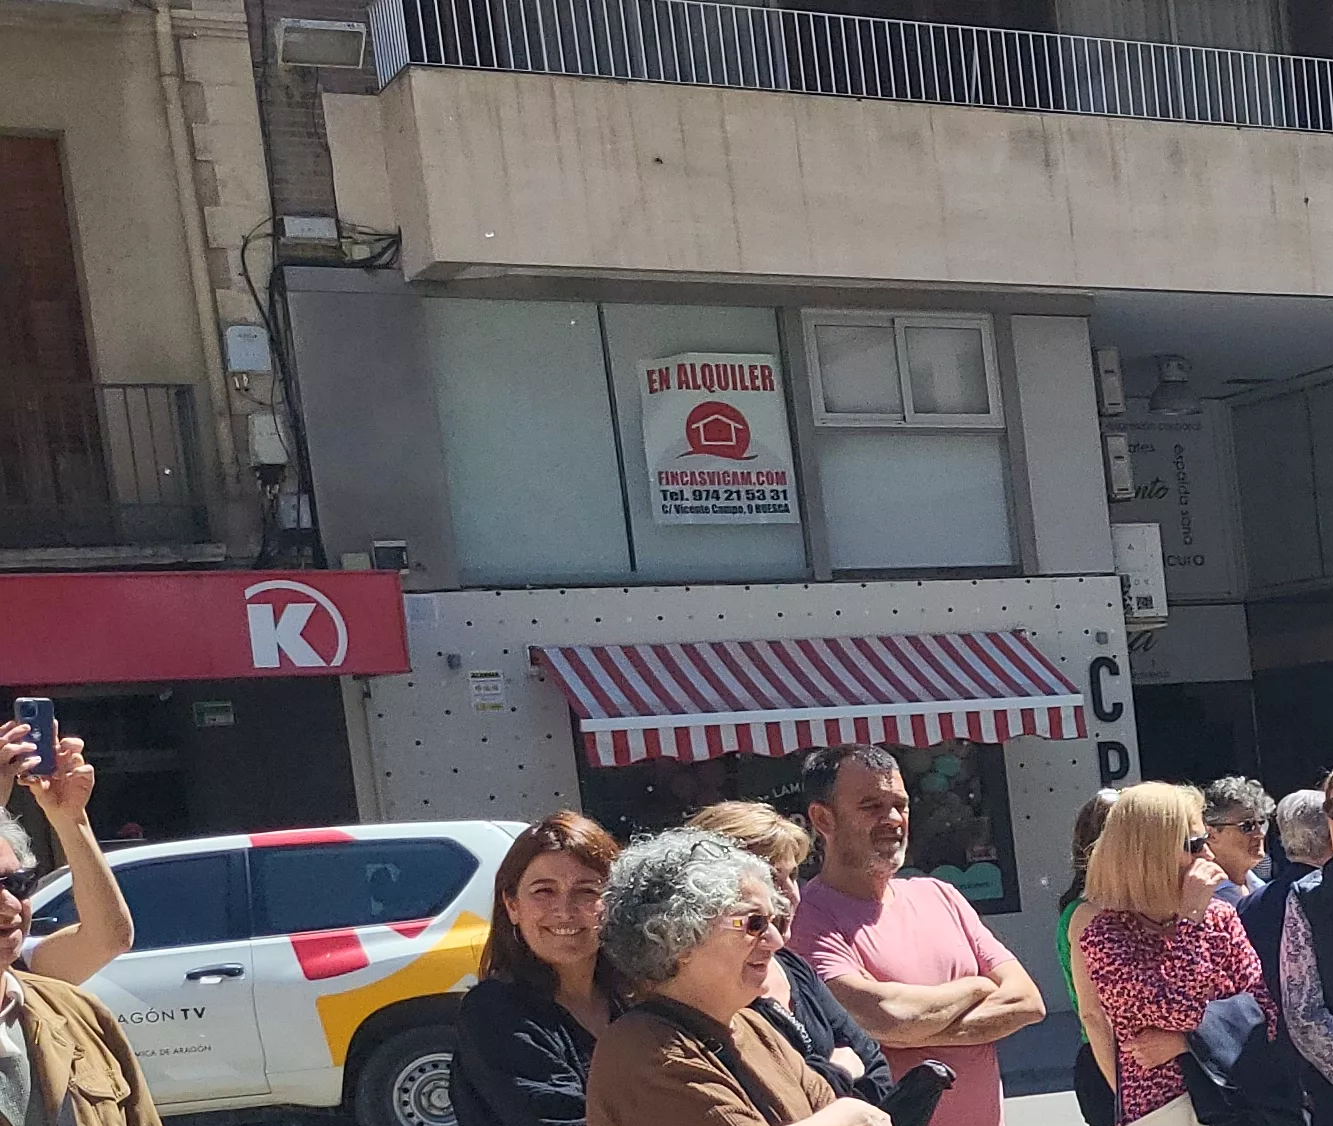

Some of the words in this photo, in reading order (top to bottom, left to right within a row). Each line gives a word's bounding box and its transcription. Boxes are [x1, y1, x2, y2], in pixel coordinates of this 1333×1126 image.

[647, 367, 671, 394] EN
[677, 363, 775, 393] ALQUILER
[658, 470, 787, 486] FINCASVICAM.COM
[660, 489, 689, 501] Tel.
[692, 489, 720, 502] 974
[724, 489, 741, 501] 21
[745, 489, 767, 501] 53
[770, 489, 788, 501] 31
[247, 603, 329, 669] K
[117, 1007, 175, 1025] AGÓN
[180, 1006, 206, 1021] TV
[159, 1048, 170, 1057] DE
[173, 1043, 212, 1056] ARAGÓN
